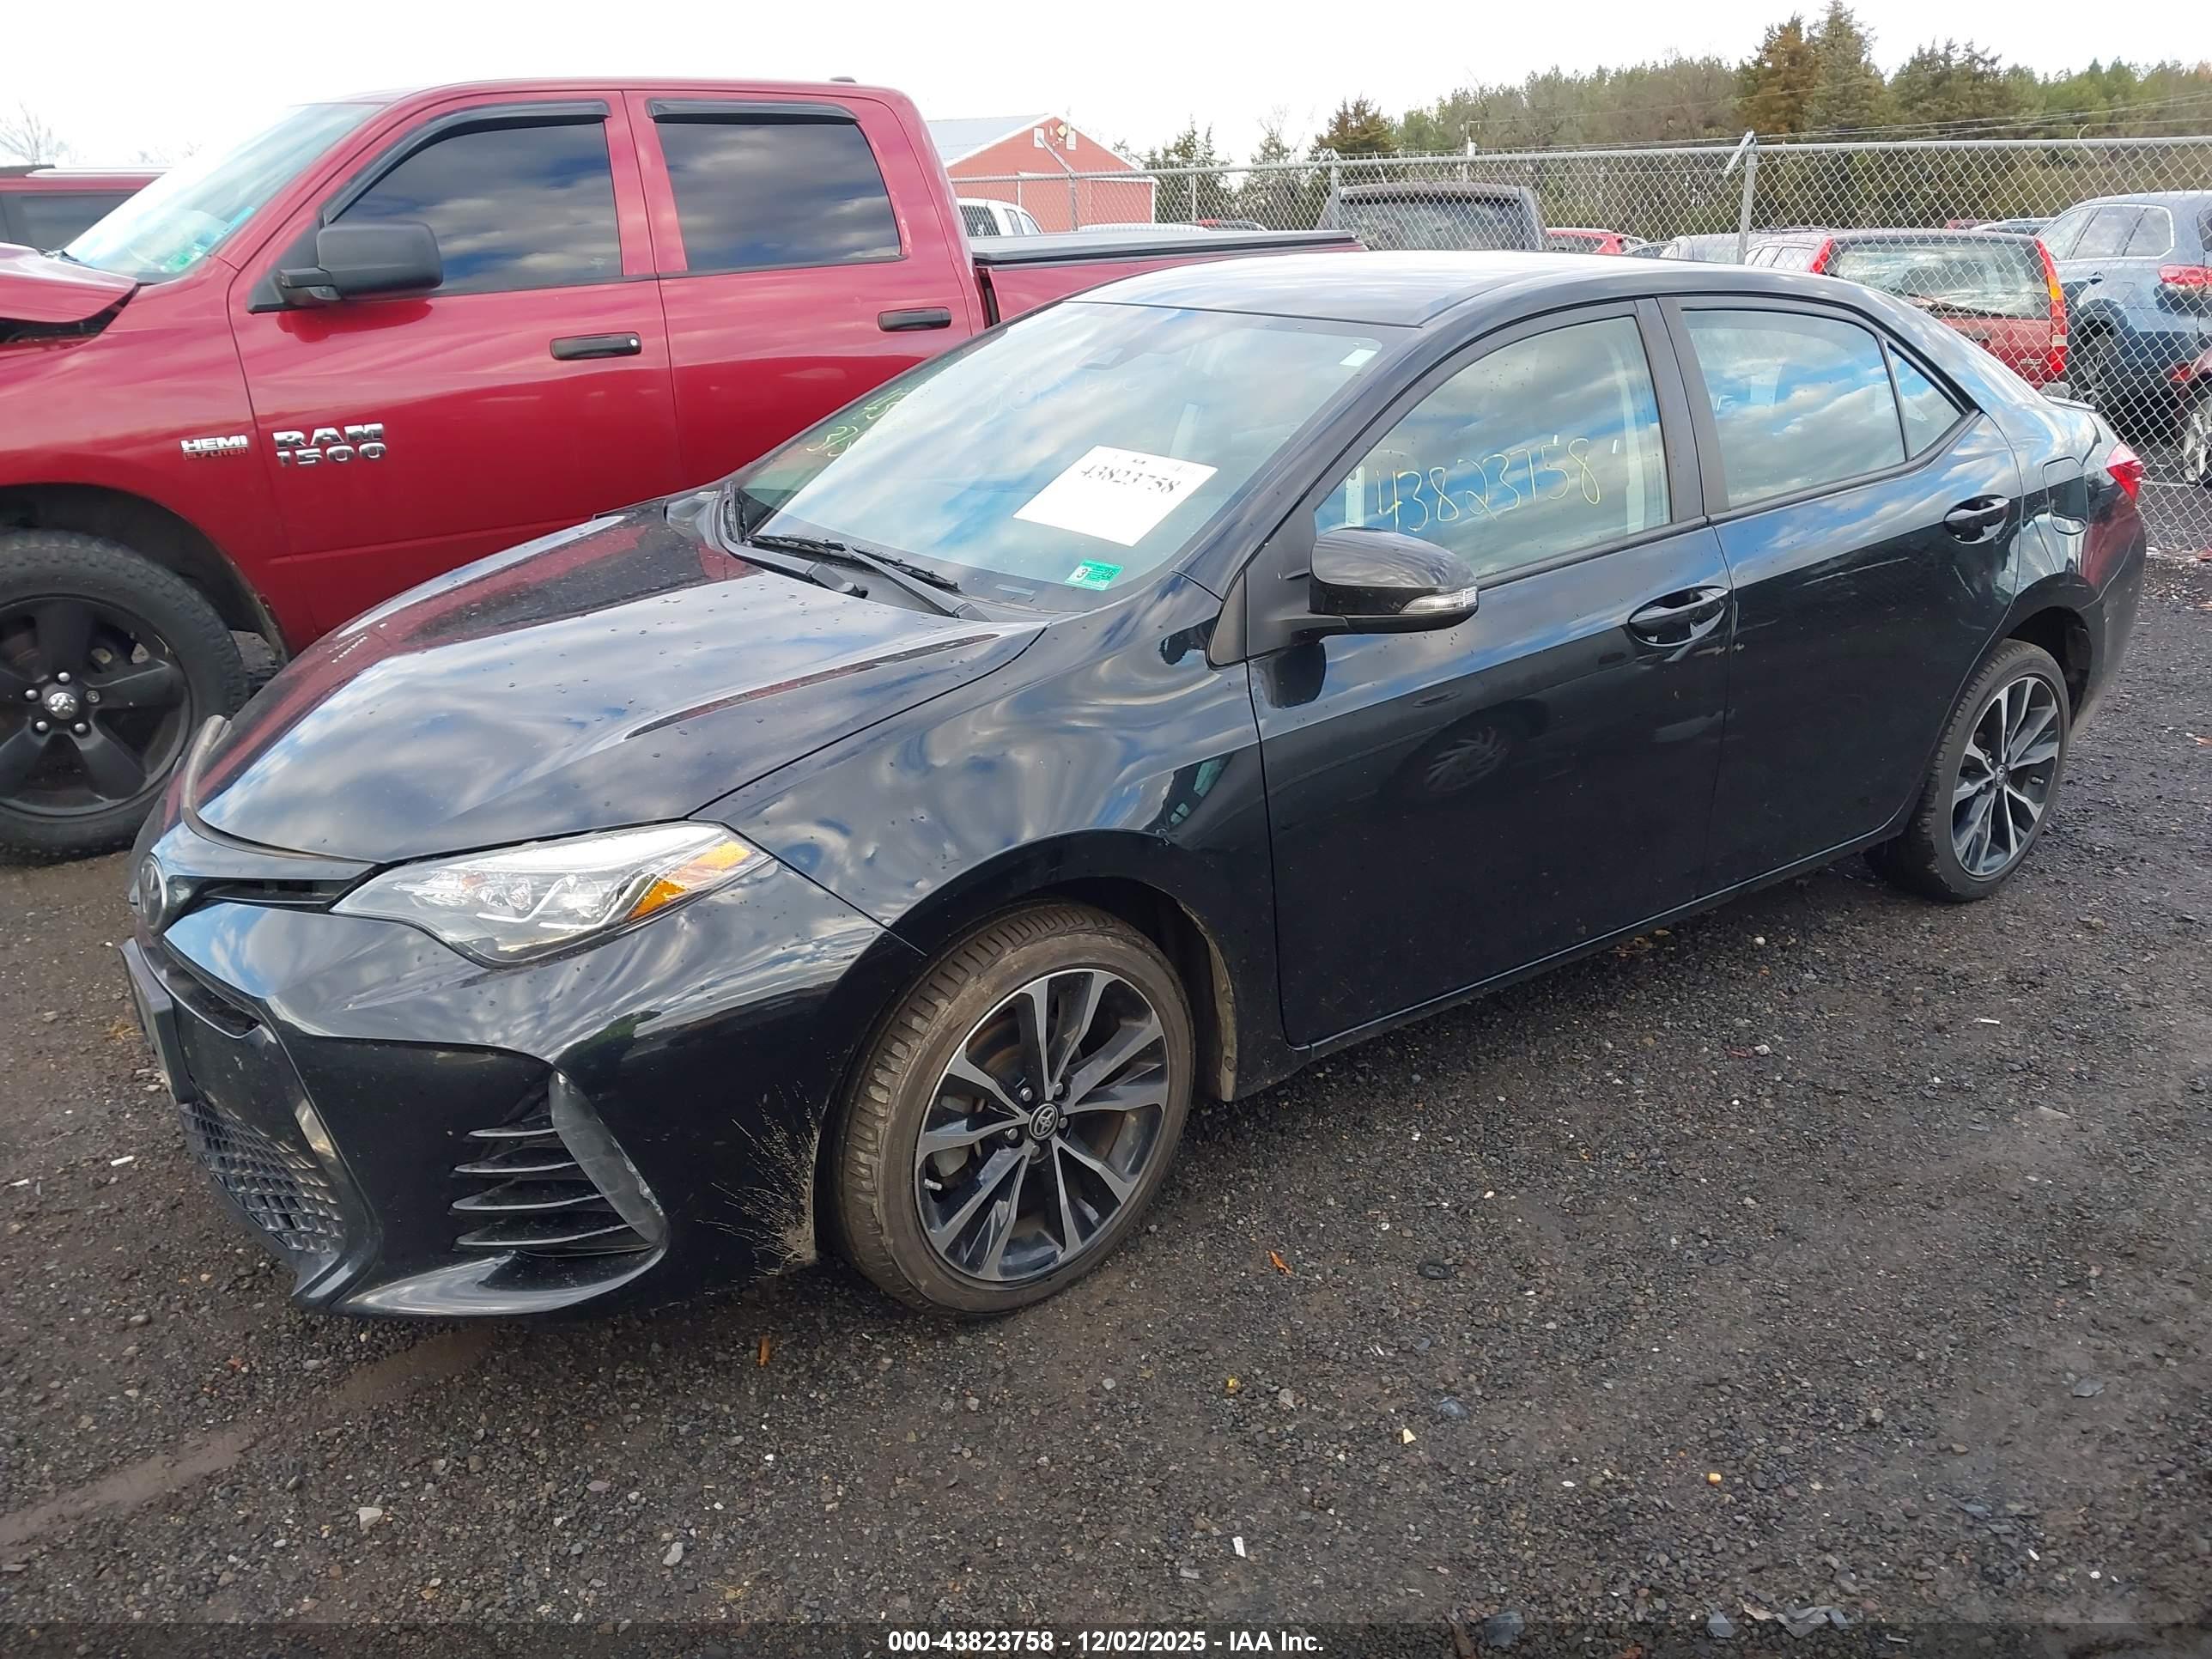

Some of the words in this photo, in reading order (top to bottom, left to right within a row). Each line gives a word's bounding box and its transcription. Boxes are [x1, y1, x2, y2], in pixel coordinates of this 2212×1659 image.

[179, 434, 248, 450] HEMI
[272, 422, 384, 448] RAM
[276, 441, 386, 468] 1500
[1376, 434, 1601, 532] 43823758
